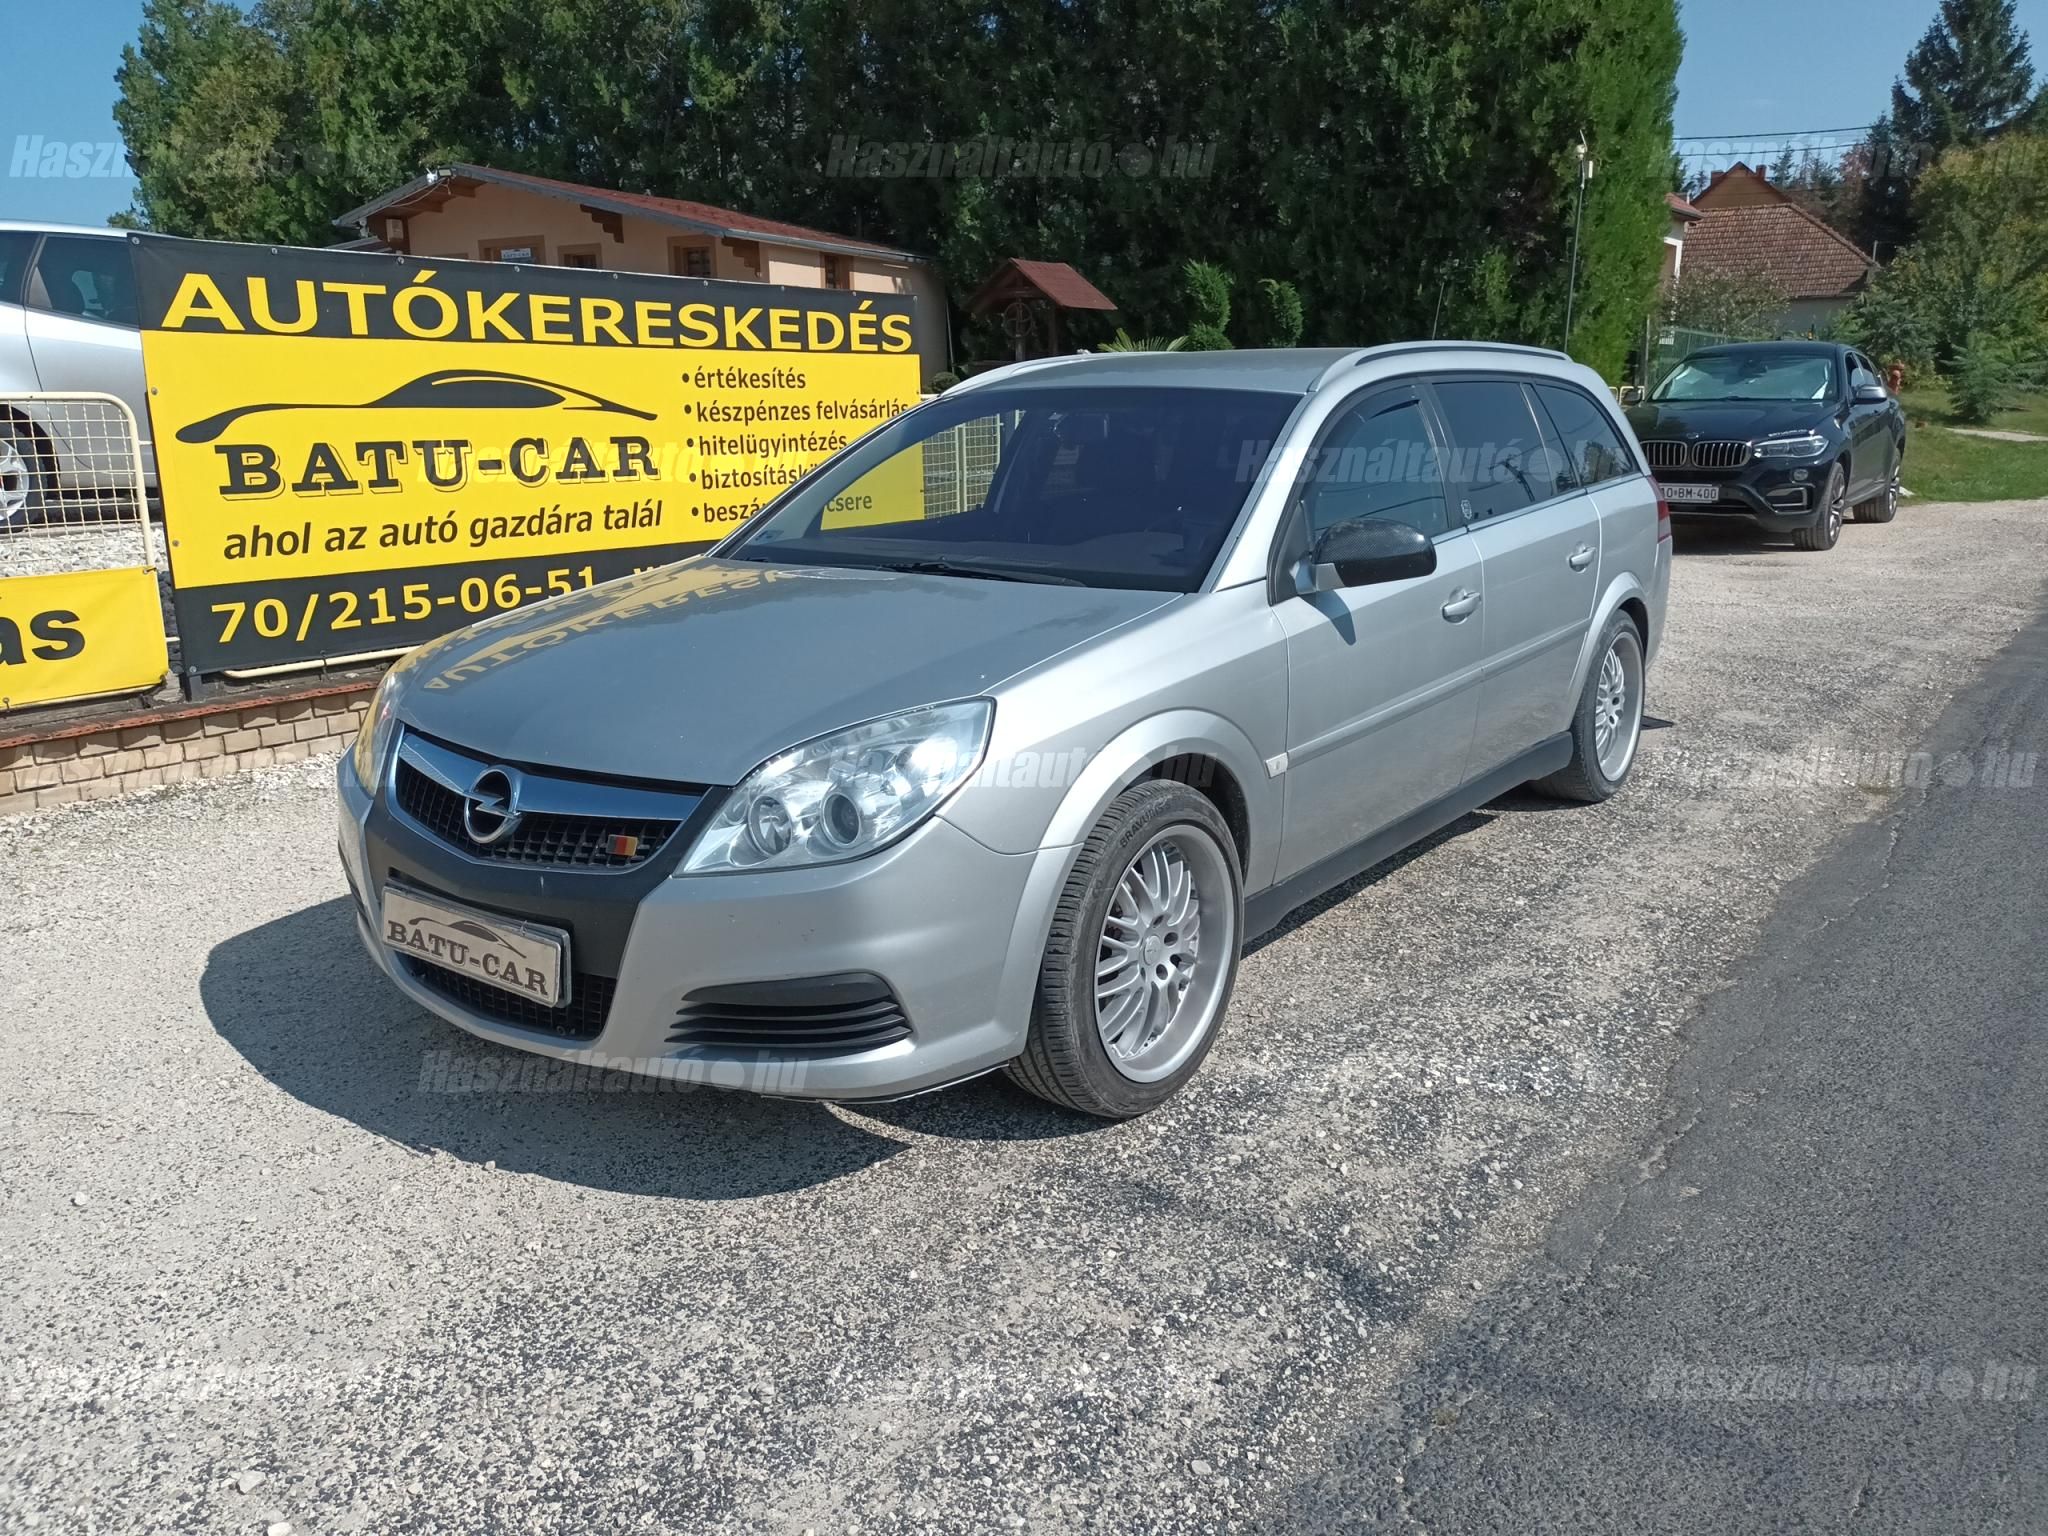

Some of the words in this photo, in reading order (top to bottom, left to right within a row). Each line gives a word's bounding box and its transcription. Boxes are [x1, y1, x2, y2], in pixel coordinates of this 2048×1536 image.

[161, 270, 912, 352] AUTÓKERESKEDÉS
[694, 366, 806, 390] értékesítés
[696, 400, 811, 426] készpénzes
[816, 398, 908, 420] felvásárlás
[699, 430, 847, 458] hitelügyintézés
[214, 437, 661, 501] BATU-CAR
[701, 463, 817, 490] biztosításk
[224, 522, 311, 560] ahol
[324, 525, 368, 553] az
[379, 510, 458, 547] autó
[469, 506, 593, 548] gazdára
[603, 499, 663, 531] talál
[703, 498, 766, 523] beszá
[827, 494, 873, 513] csere
[210, 565, 598, 644] 70/215-06-51
[386, 919, 549, 996] BATU-CAR
